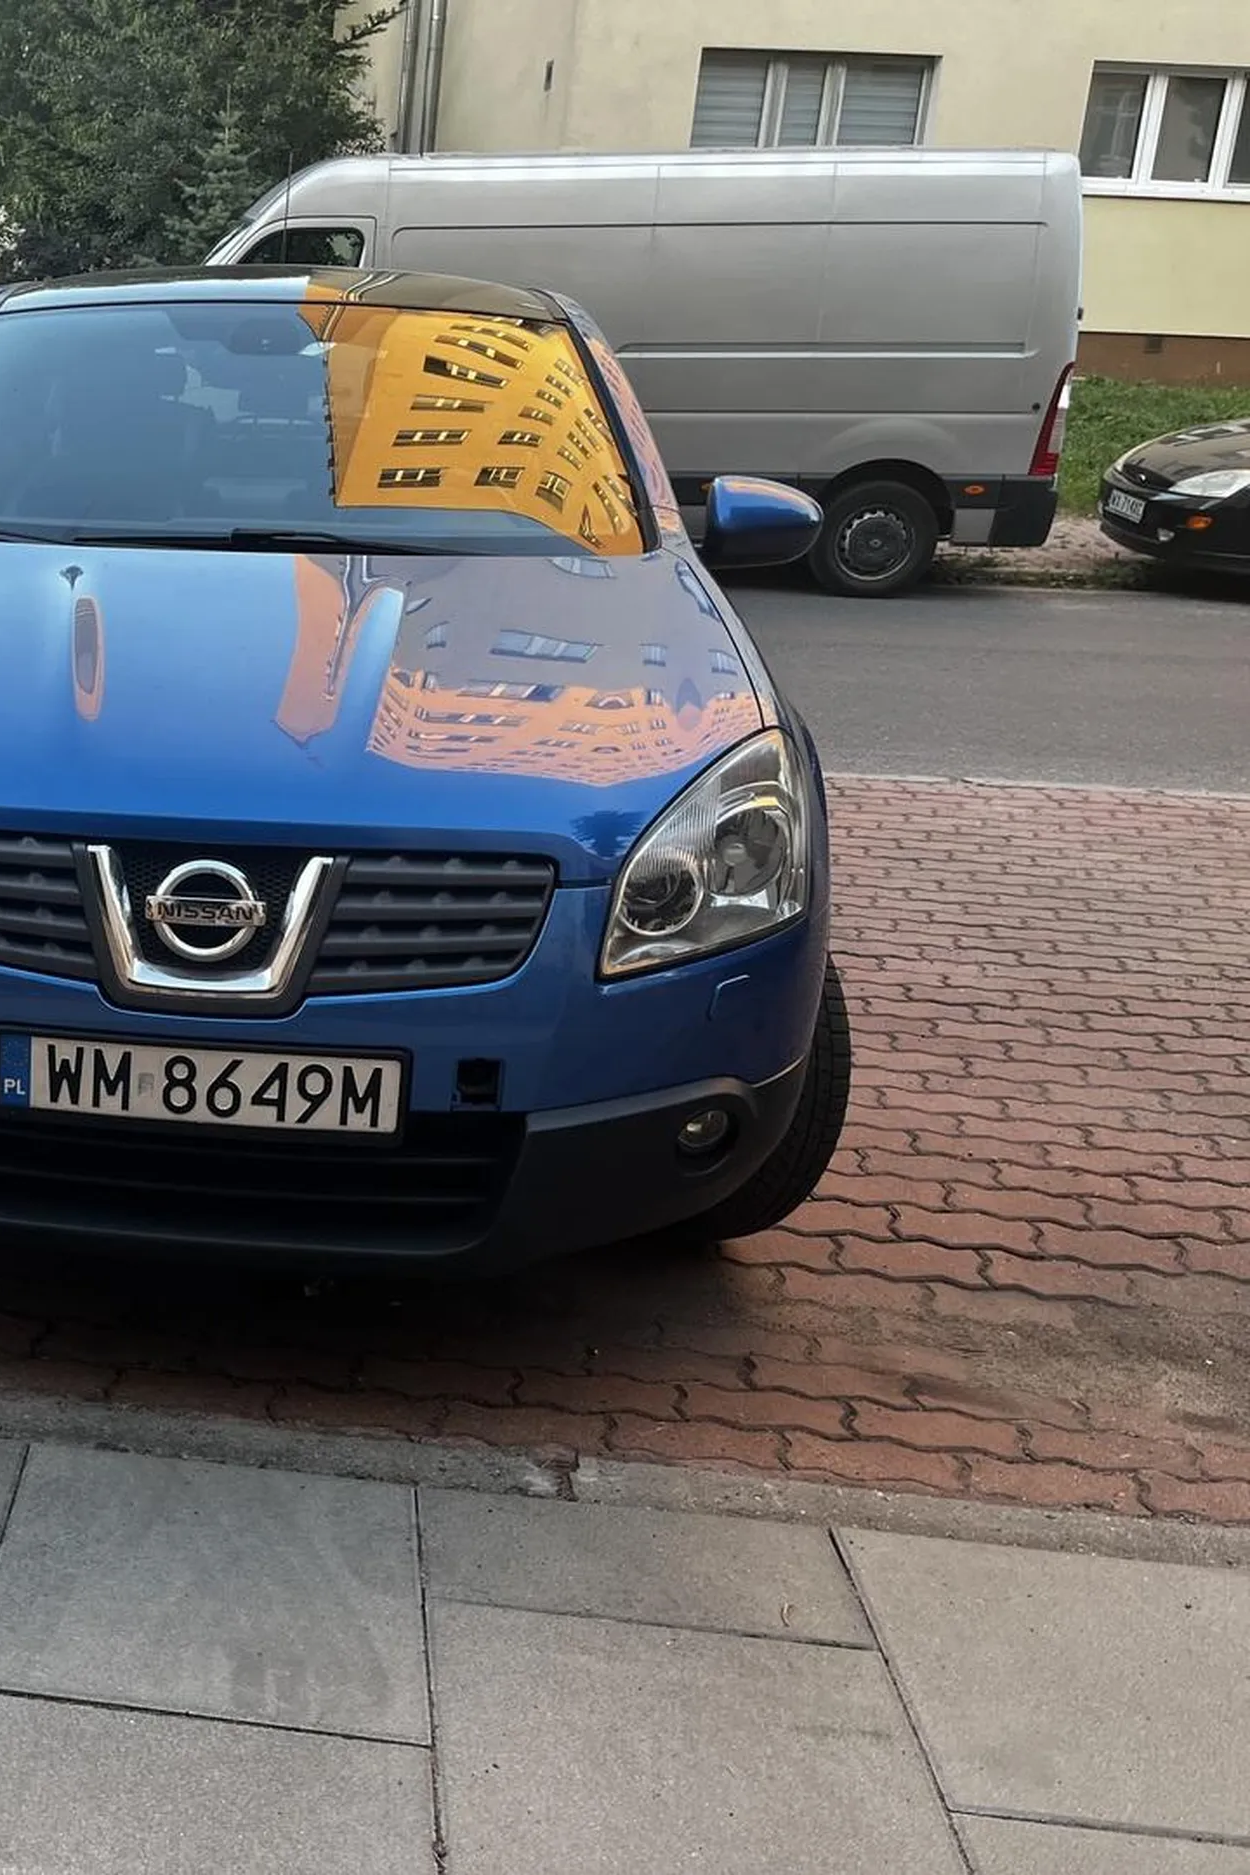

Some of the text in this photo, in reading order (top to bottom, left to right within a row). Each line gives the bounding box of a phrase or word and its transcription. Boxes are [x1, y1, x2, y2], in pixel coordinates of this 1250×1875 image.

[156, 900, 254, 921] NISSAN
[3, 1077, 27, 1096] PL
[47, 1043, 383, 1128] WM 8649M
